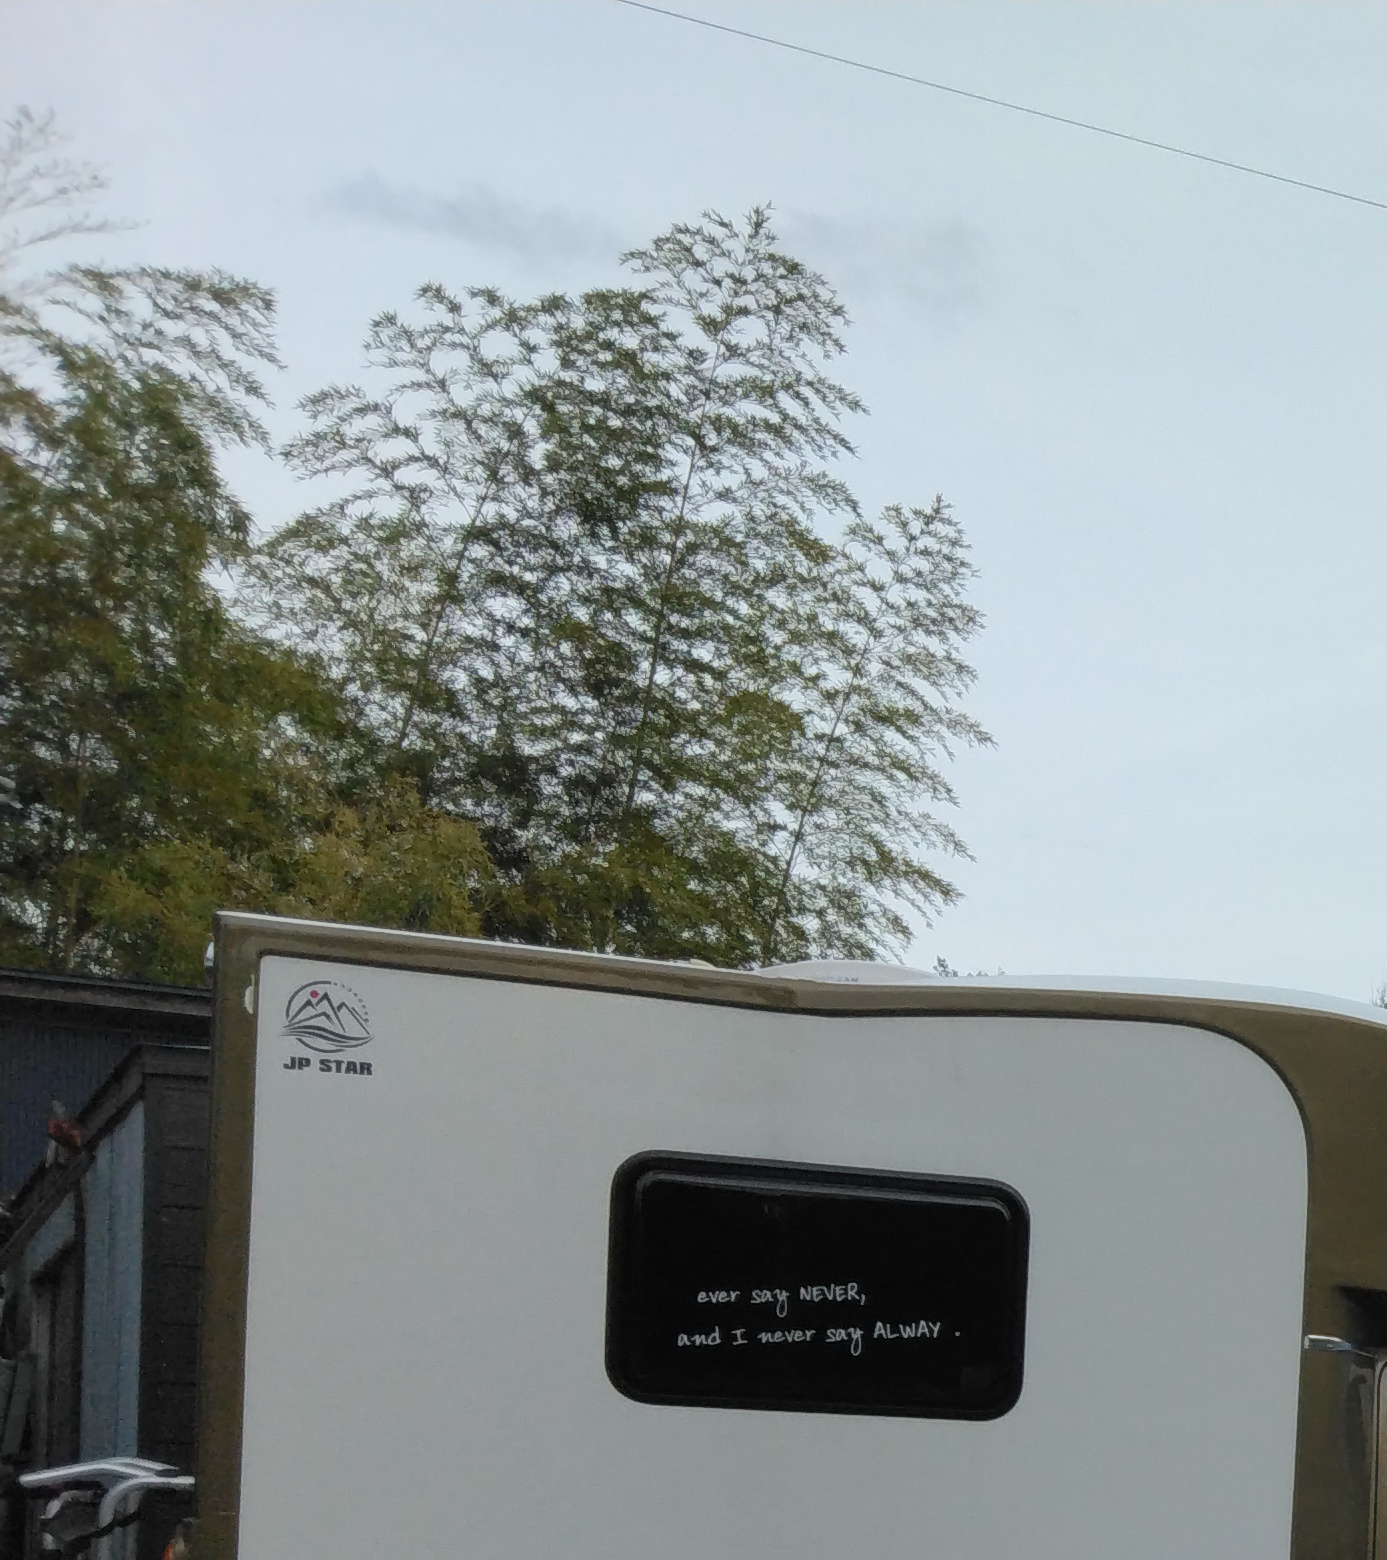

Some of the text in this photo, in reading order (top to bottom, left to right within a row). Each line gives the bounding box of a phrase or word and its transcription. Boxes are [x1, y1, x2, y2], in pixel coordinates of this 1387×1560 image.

[283, 1056, 373, 1076] JP STAR
[697, 1282, 867, 1318] ever say NEVER,
[677, 1326, 721, 1347] and
[732, 1328, 749, 1345] I
[757, 1327, 816, 1344] never
[825, 1326, 864, 1356] say
